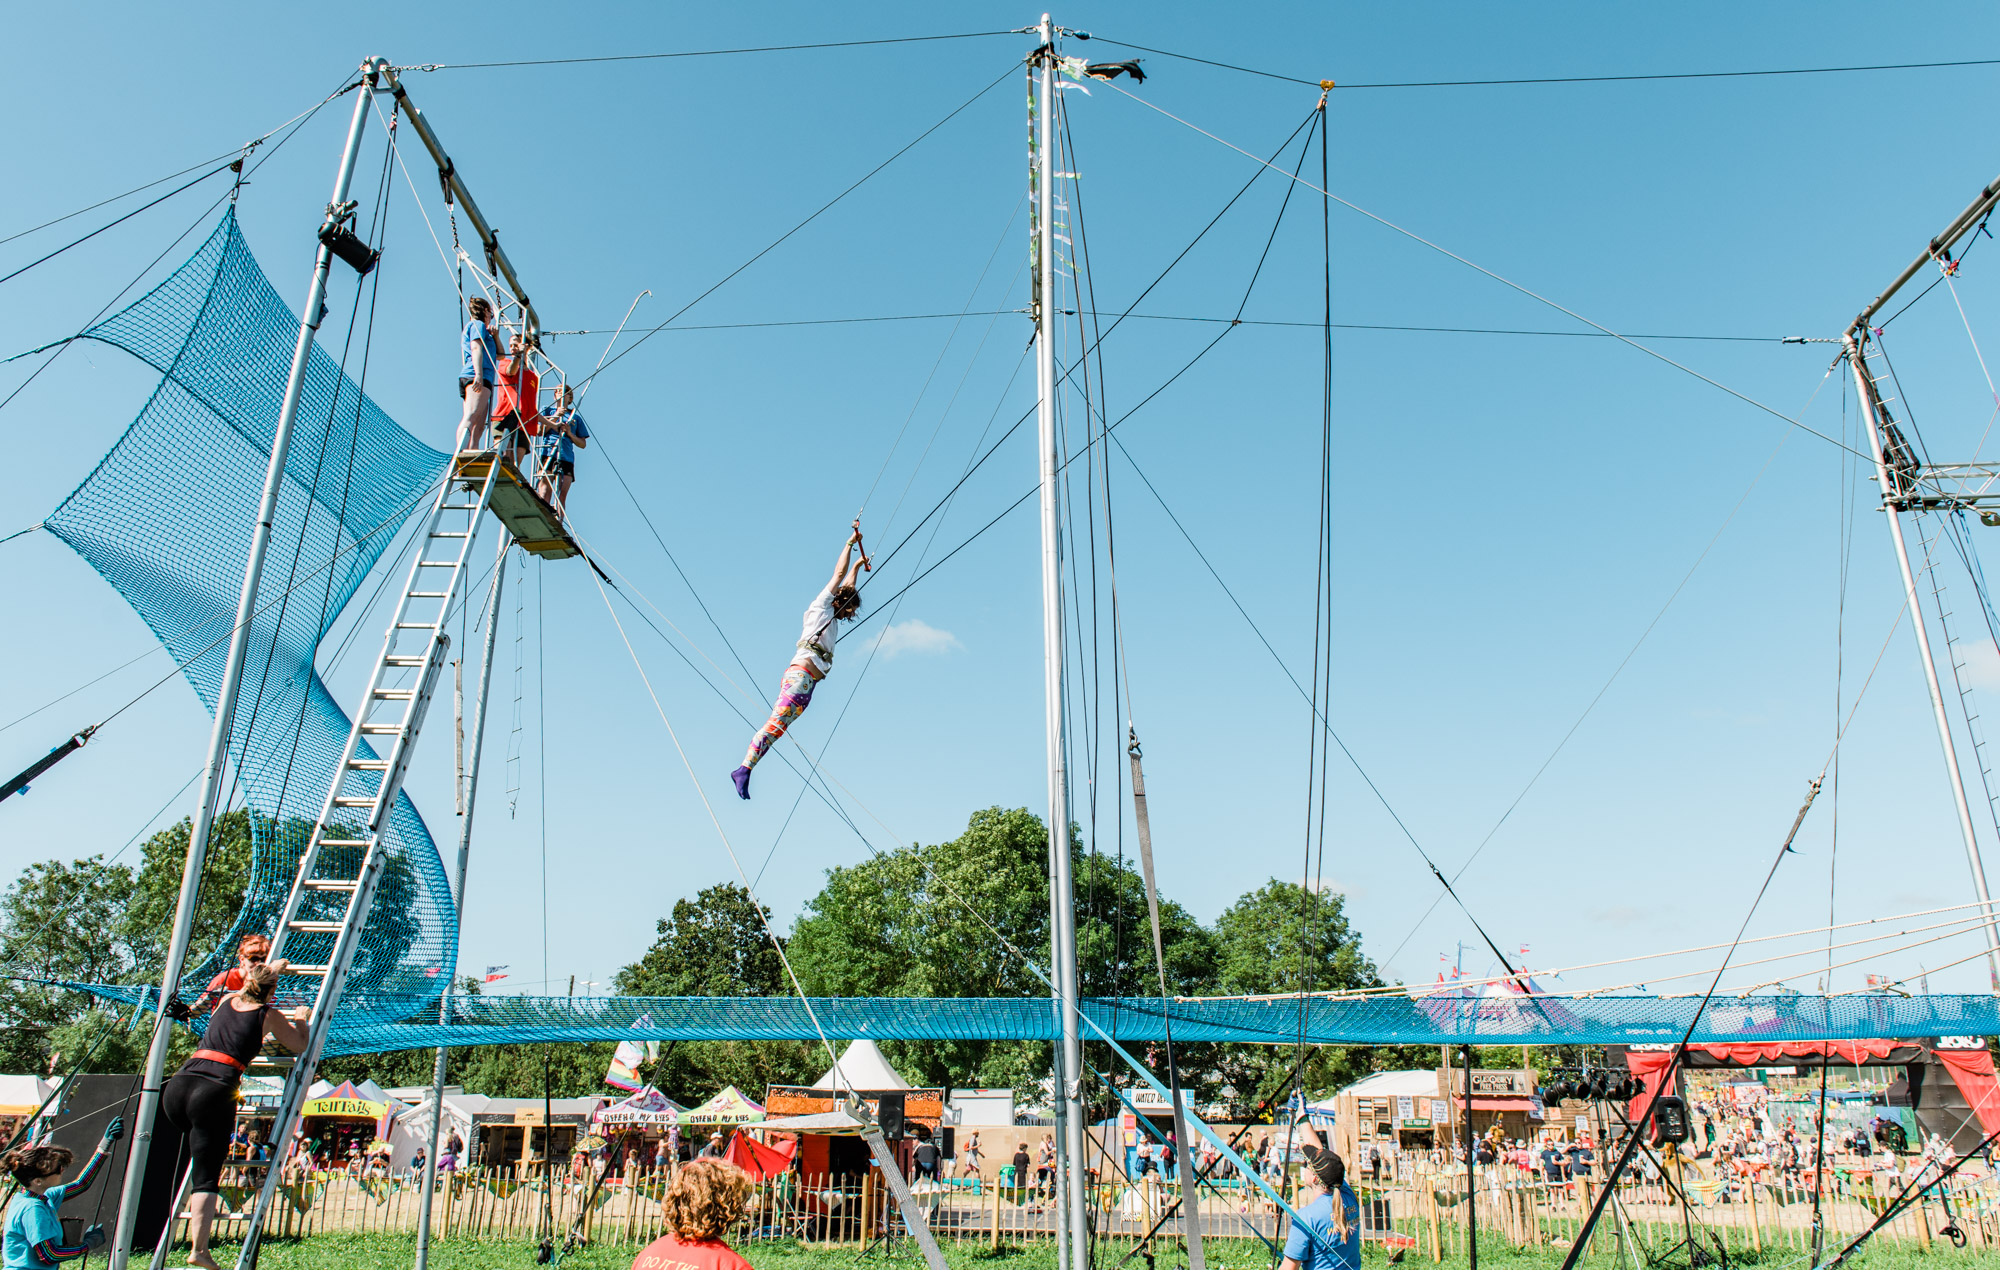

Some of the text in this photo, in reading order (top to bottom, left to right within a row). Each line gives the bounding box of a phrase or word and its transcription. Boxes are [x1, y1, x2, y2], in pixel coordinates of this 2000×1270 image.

[1135, 1092, 1156, 1104] WATER
[604, 1112, 670, 1123] OFFEND MY EYES
[690, 1114, 750, 1124] OFFEND MY EYES
[642, 1256, 659, 1268] DO
[658, 1259, 676, 1270] IT
